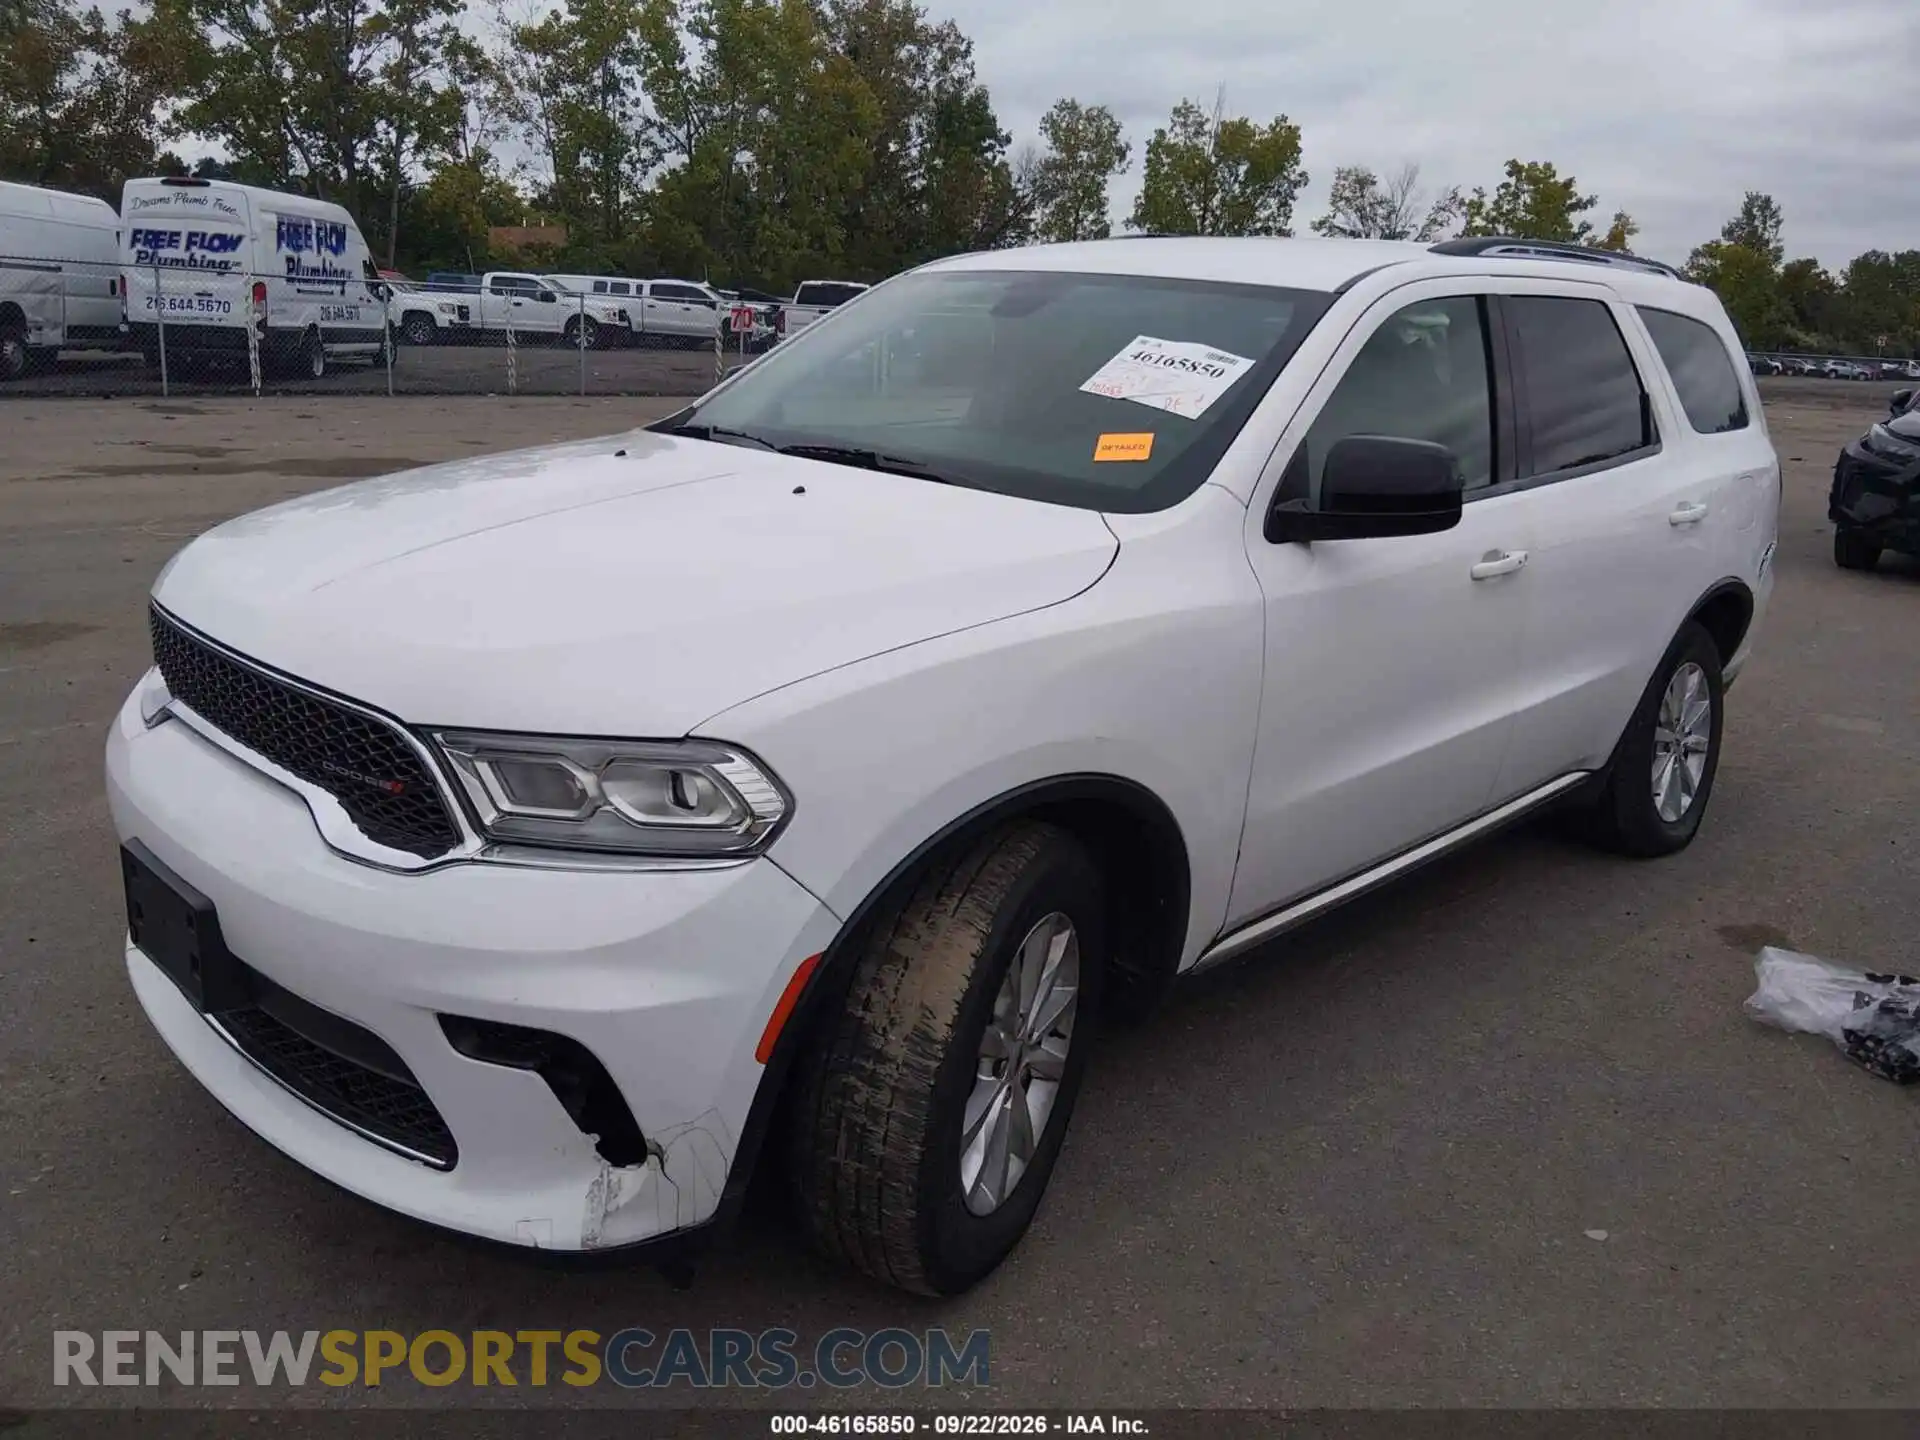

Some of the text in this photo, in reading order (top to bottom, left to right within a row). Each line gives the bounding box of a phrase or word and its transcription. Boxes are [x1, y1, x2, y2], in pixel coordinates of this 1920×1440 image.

[130, 228, 246, 253] FREE FLOW
[277, 216, 347, 257] FREE FLOW
[135, 249, 232, 275] Plumbing
[285, 255, 346, 295] Plumbing
[731, 308, 752, 328] 70
[1130, 350, 1225, 378] 46165850
